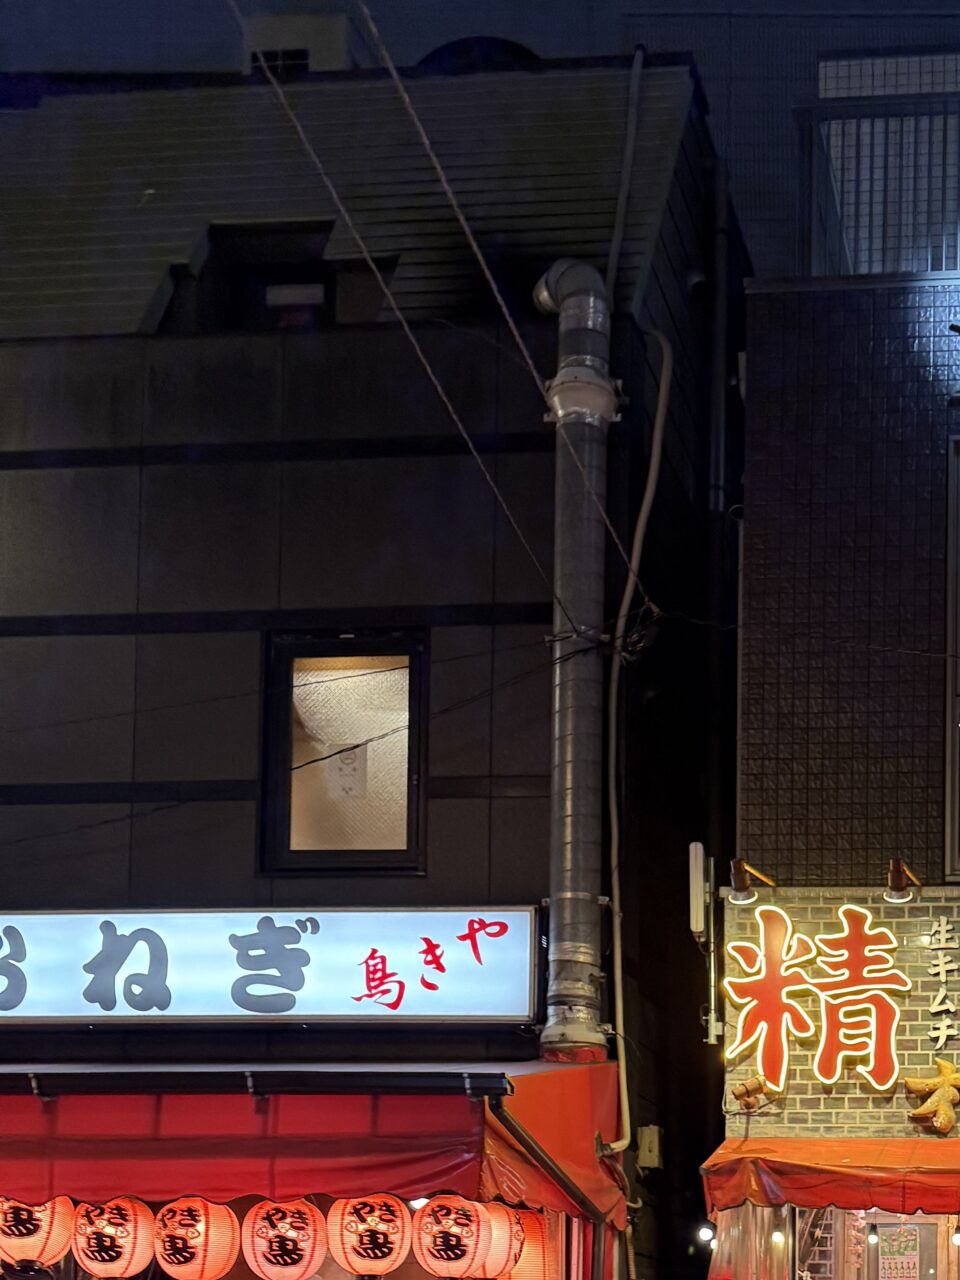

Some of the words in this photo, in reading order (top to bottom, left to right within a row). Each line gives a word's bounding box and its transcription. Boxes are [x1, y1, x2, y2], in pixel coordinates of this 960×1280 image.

[724, 905, 911, 1091] 精
[927, 916, 959, 1050] 生キムチ
